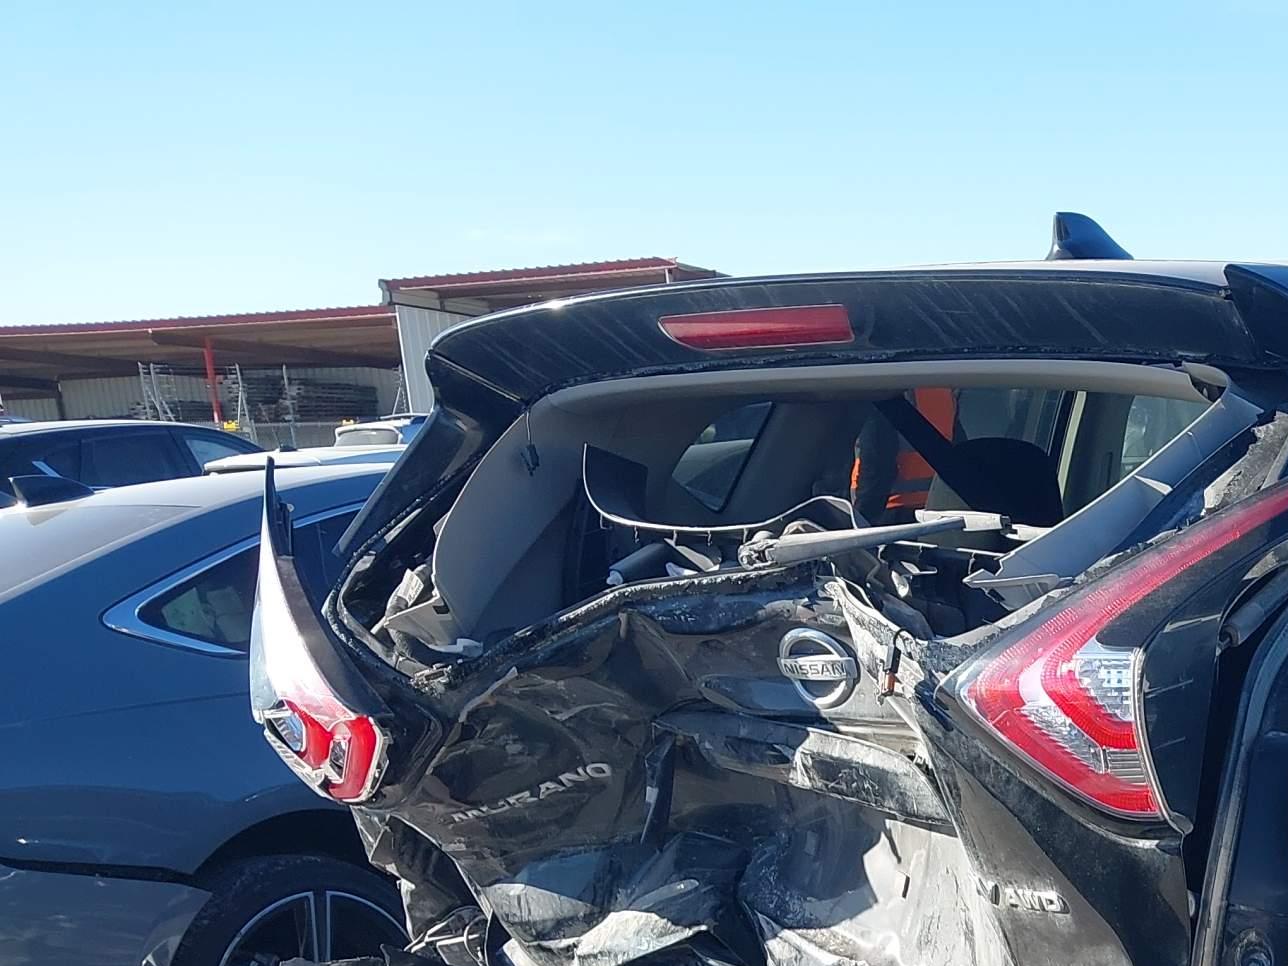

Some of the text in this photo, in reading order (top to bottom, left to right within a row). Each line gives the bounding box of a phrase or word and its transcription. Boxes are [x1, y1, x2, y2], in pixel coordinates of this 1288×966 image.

[783, 662, 848, 677] NISSAN
[449, 762, 612, 824] MURANO
[1003, 887, 1062, 913] AWD
